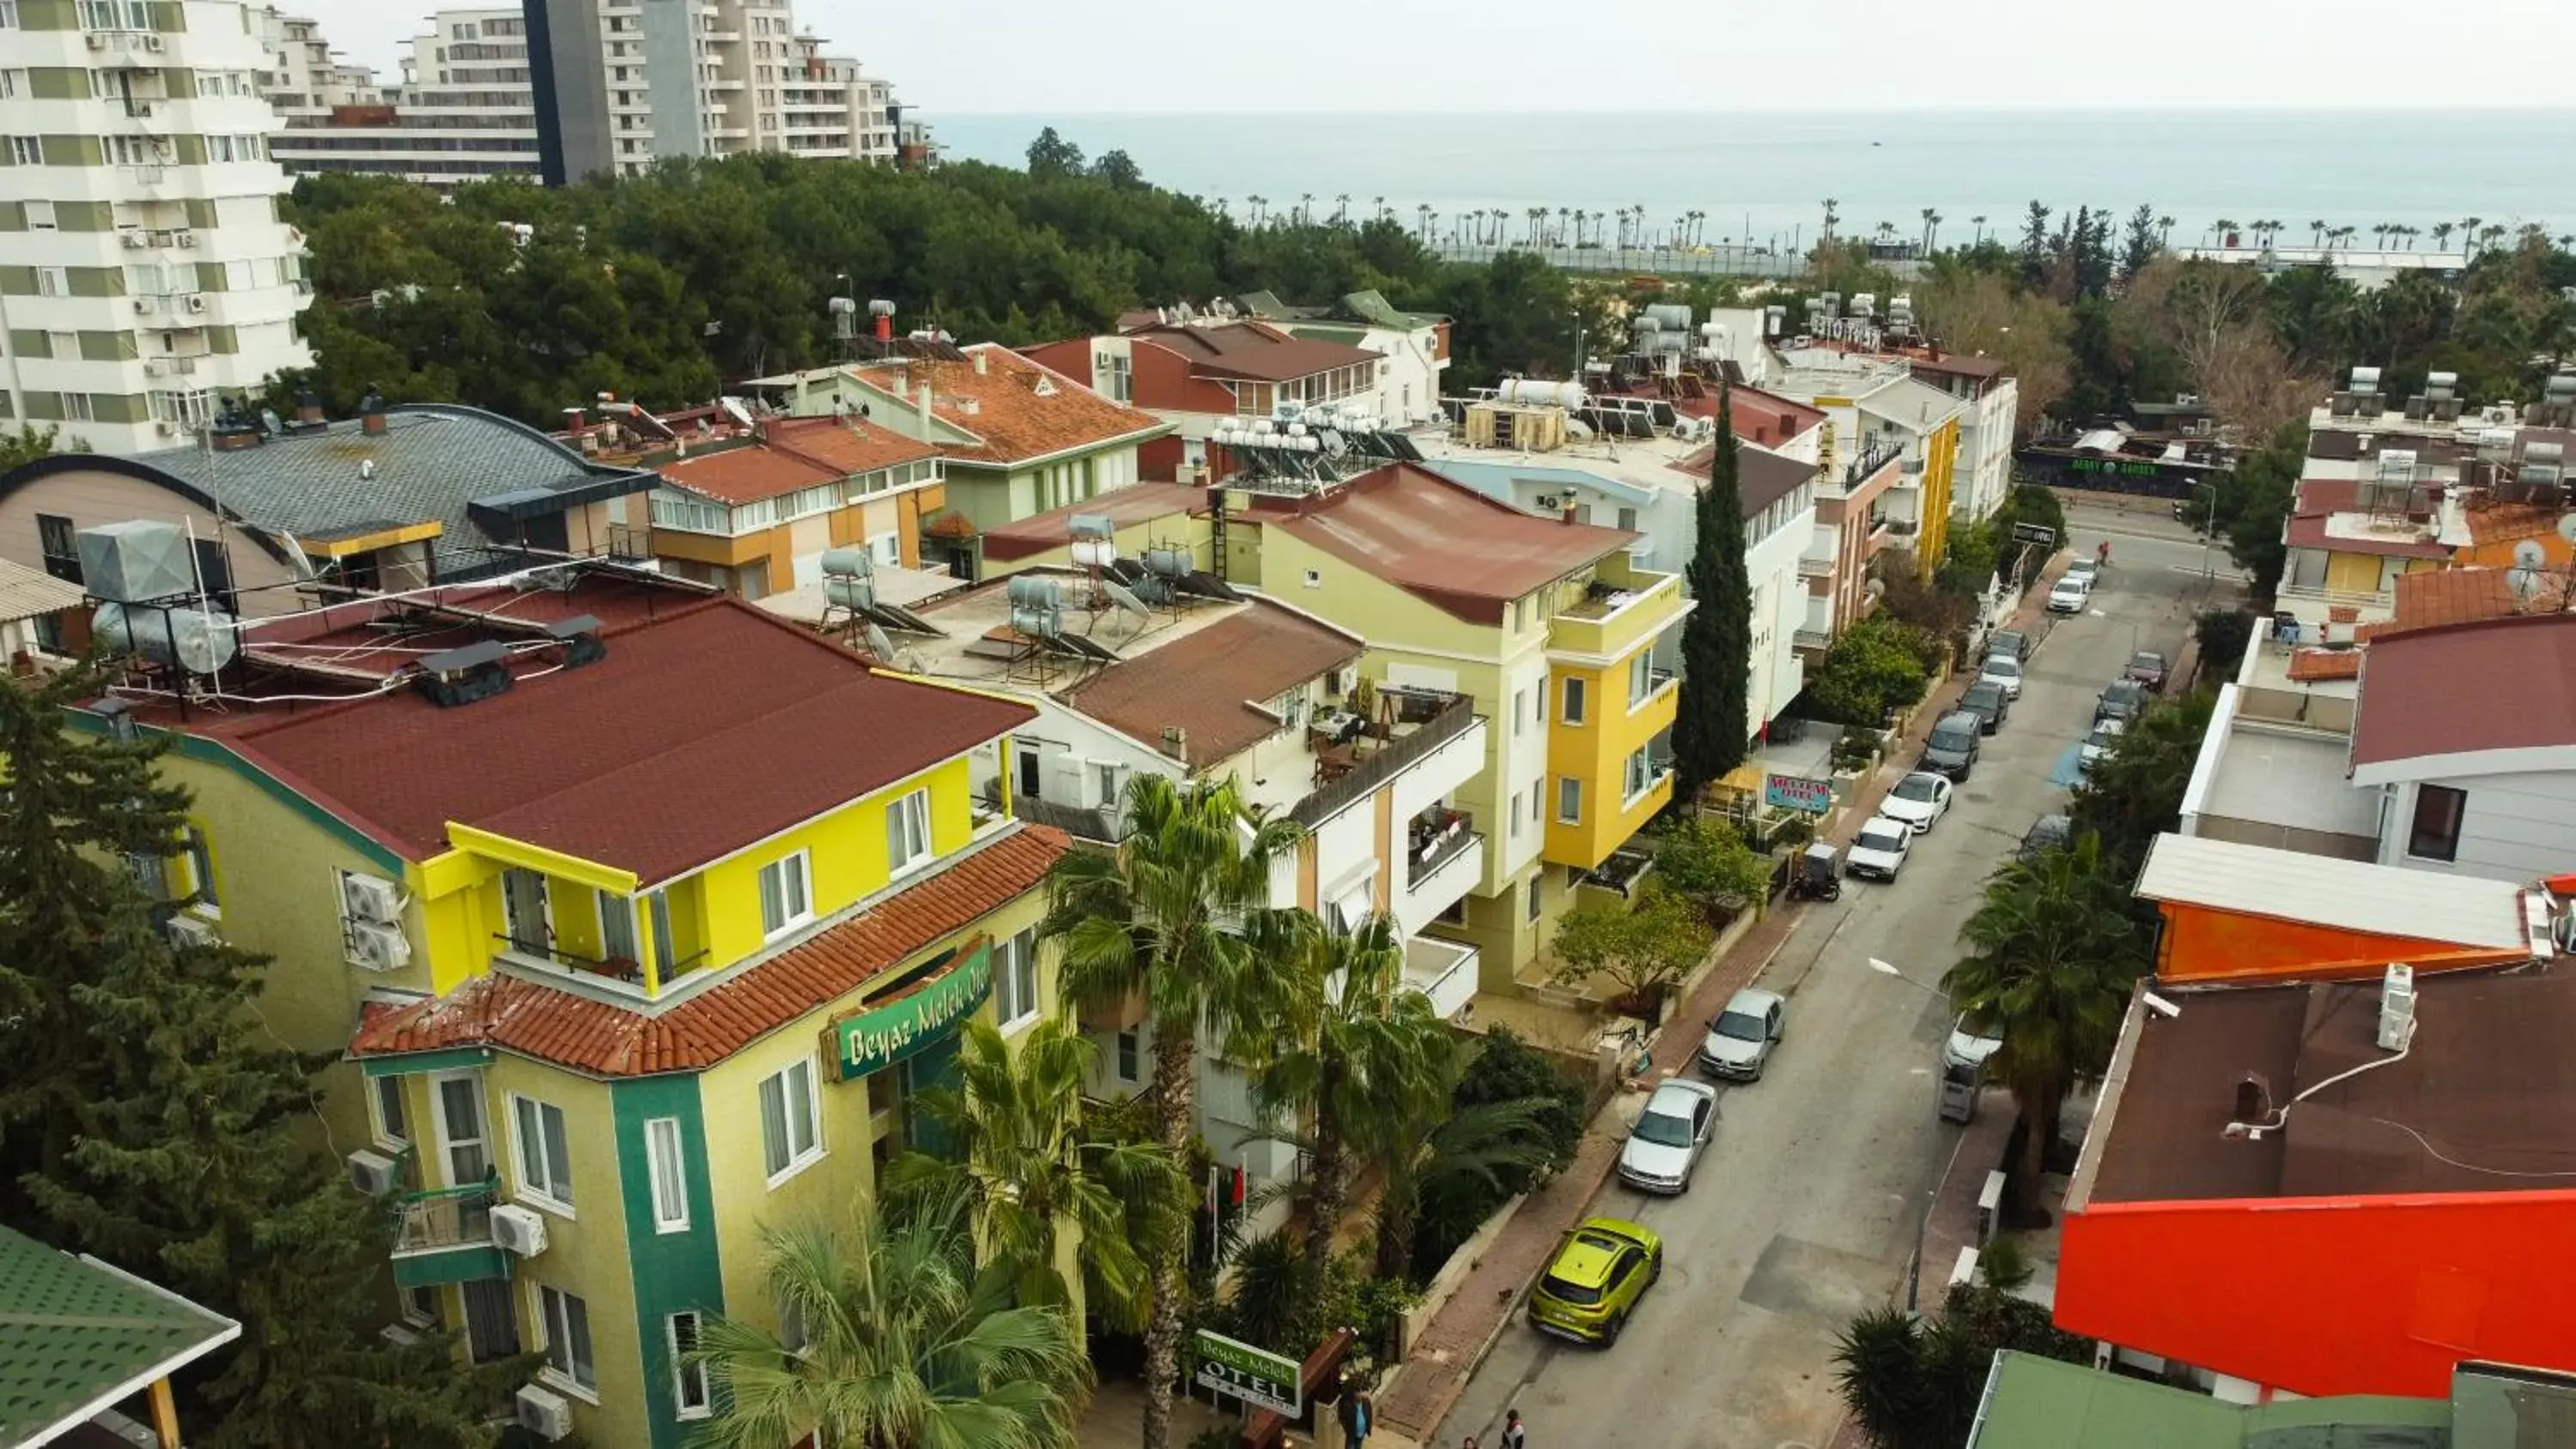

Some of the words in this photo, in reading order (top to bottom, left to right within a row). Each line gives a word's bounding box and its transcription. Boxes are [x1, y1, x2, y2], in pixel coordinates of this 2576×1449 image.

[848, 1018, 912, 1065] Beyaz
[918, 981, 963, 1037] Melek
[1203, 1341, 1242, 1364] Beyaz
[1249, 1355, 1290, 1381] Melek
[1205, 1361, 1286, 1401] OTEL
